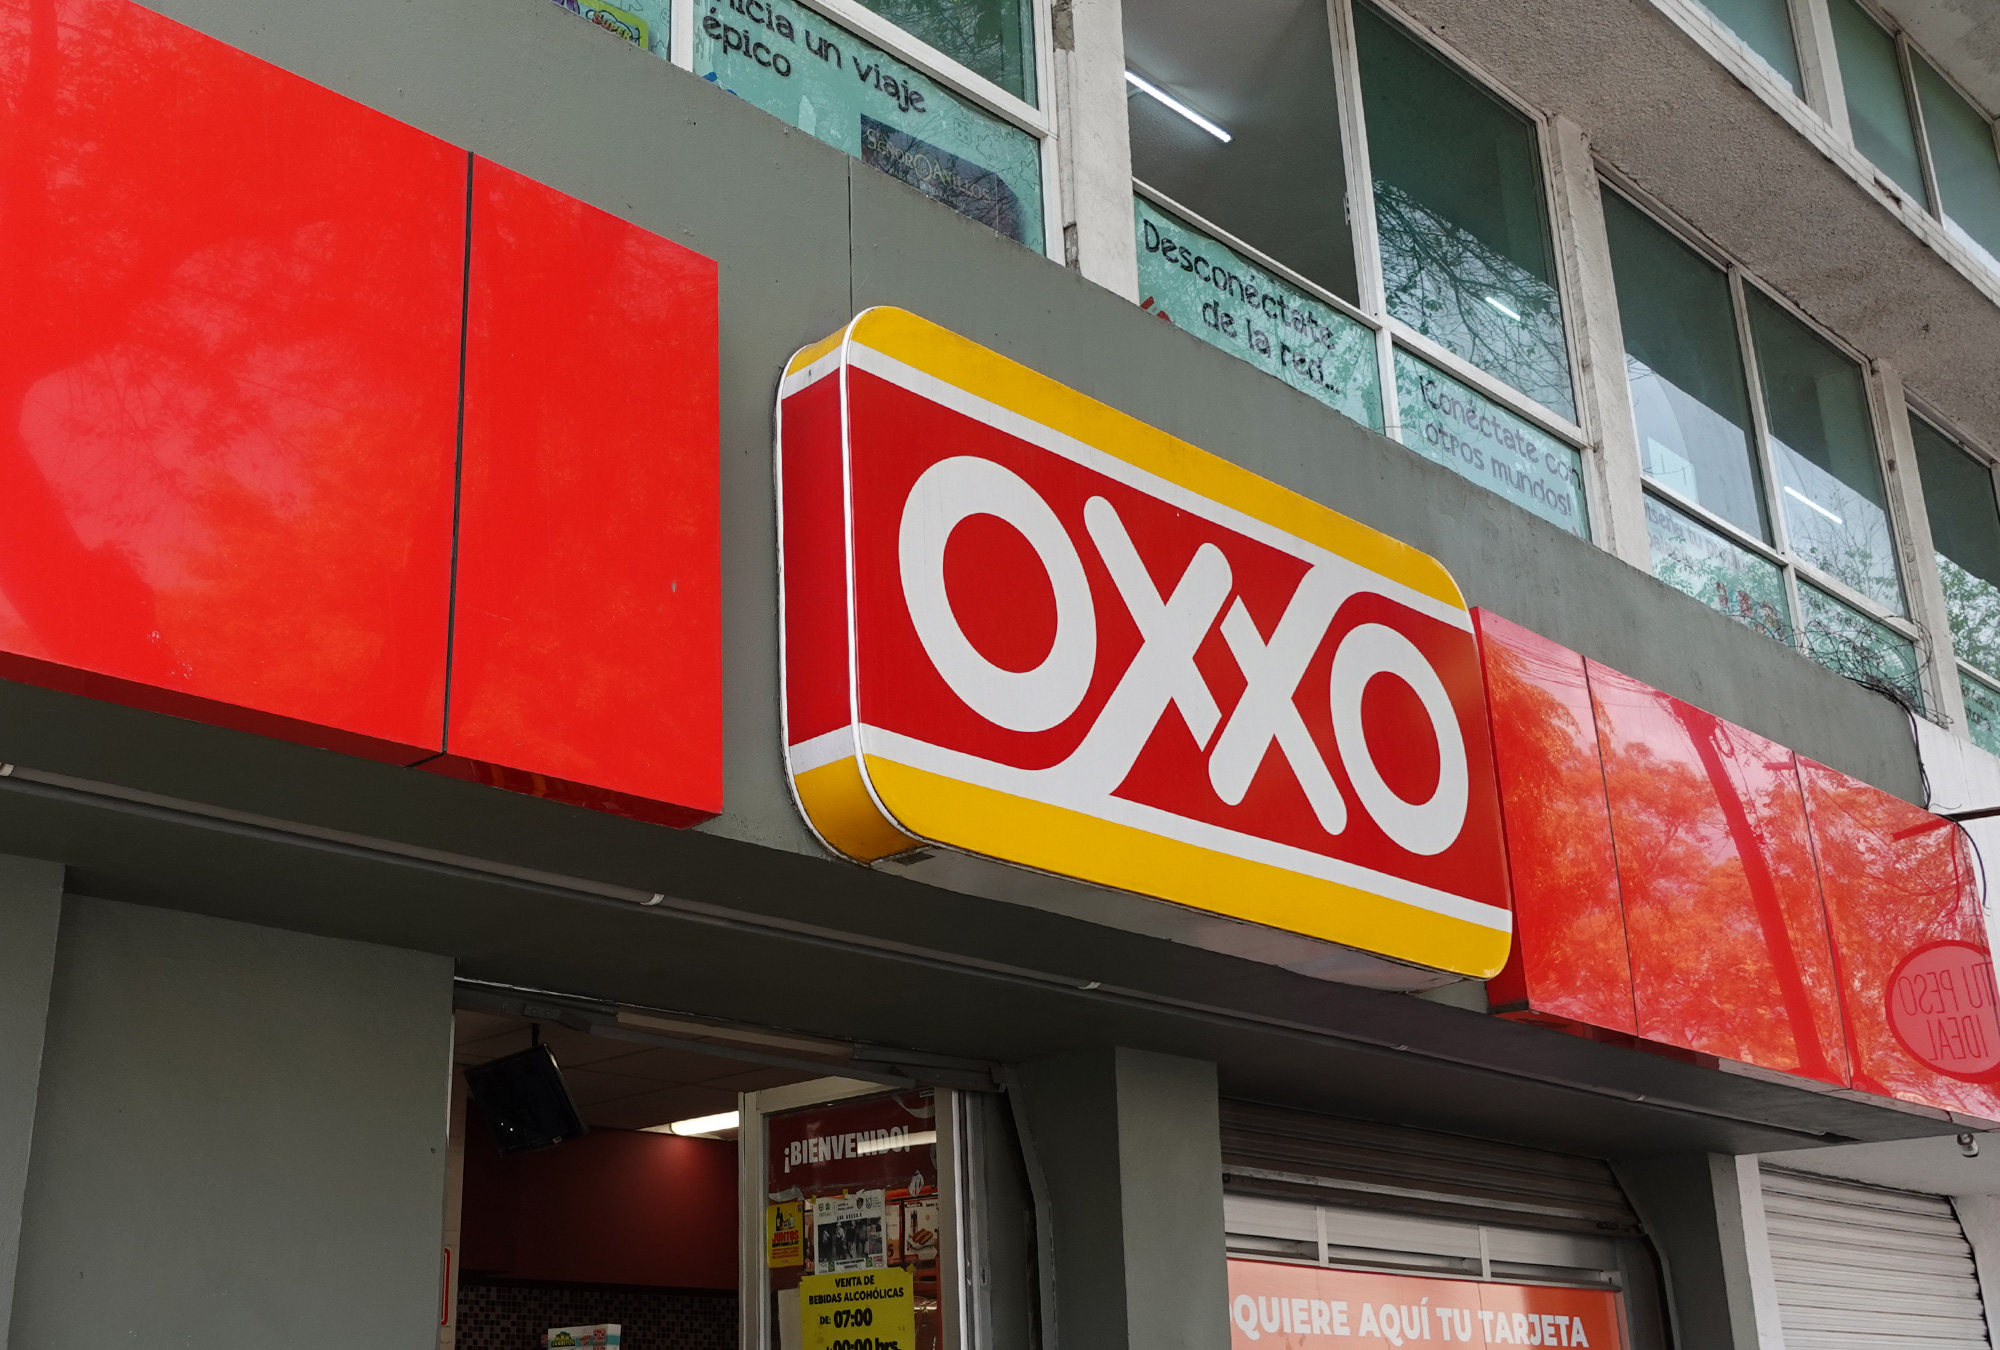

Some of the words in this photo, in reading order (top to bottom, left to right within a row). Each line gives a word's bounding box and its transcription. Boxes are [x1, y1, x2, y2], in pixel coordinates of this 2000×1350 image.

[591, 10, 632, 40] SUPER
[702, 7, 791, 78] épico
[805, 29, 842, 69] un
[852, 55, 927, 114] viaje
[933, 159, 992, 204] ANILLOS
[1142, 218, 1337, 352] Desconéctate
[1201, 299, 1238, 339] de
[1247, 314, 1272, 360] la
[1419, 375, 1539, 464] ¡Conéctate
[1544, 451, 1583, 491] con
[1425, 420, 1485, 472] otros
[1491, 456, 1573, 517] mundos!
[898, 455, 1469, 857] OXXO
[783, 1125, 911, 1174] ¡BIENVENIDO!
[808, 1292, 843, 1306] BEBIDAS
[843, 1286, 905, 1303] ALCOHÓLICAS
[834, 1276, 862, 1288] VENTA
[863, 1274, 876, 1286] DE
[819, 1315, 832, 1325] DE:
[833, 1307, 873, 1329] 07:00
[874, 1337, 903, 1350] hrs
[1229, 1293, 1351, 1341] QUIERE
[1358, 1296, 1431, 1347] AQUÍ
[1436, 1306, 1473, 1343] TU
[1477, 1309, 1589, 1349] TARJETA
